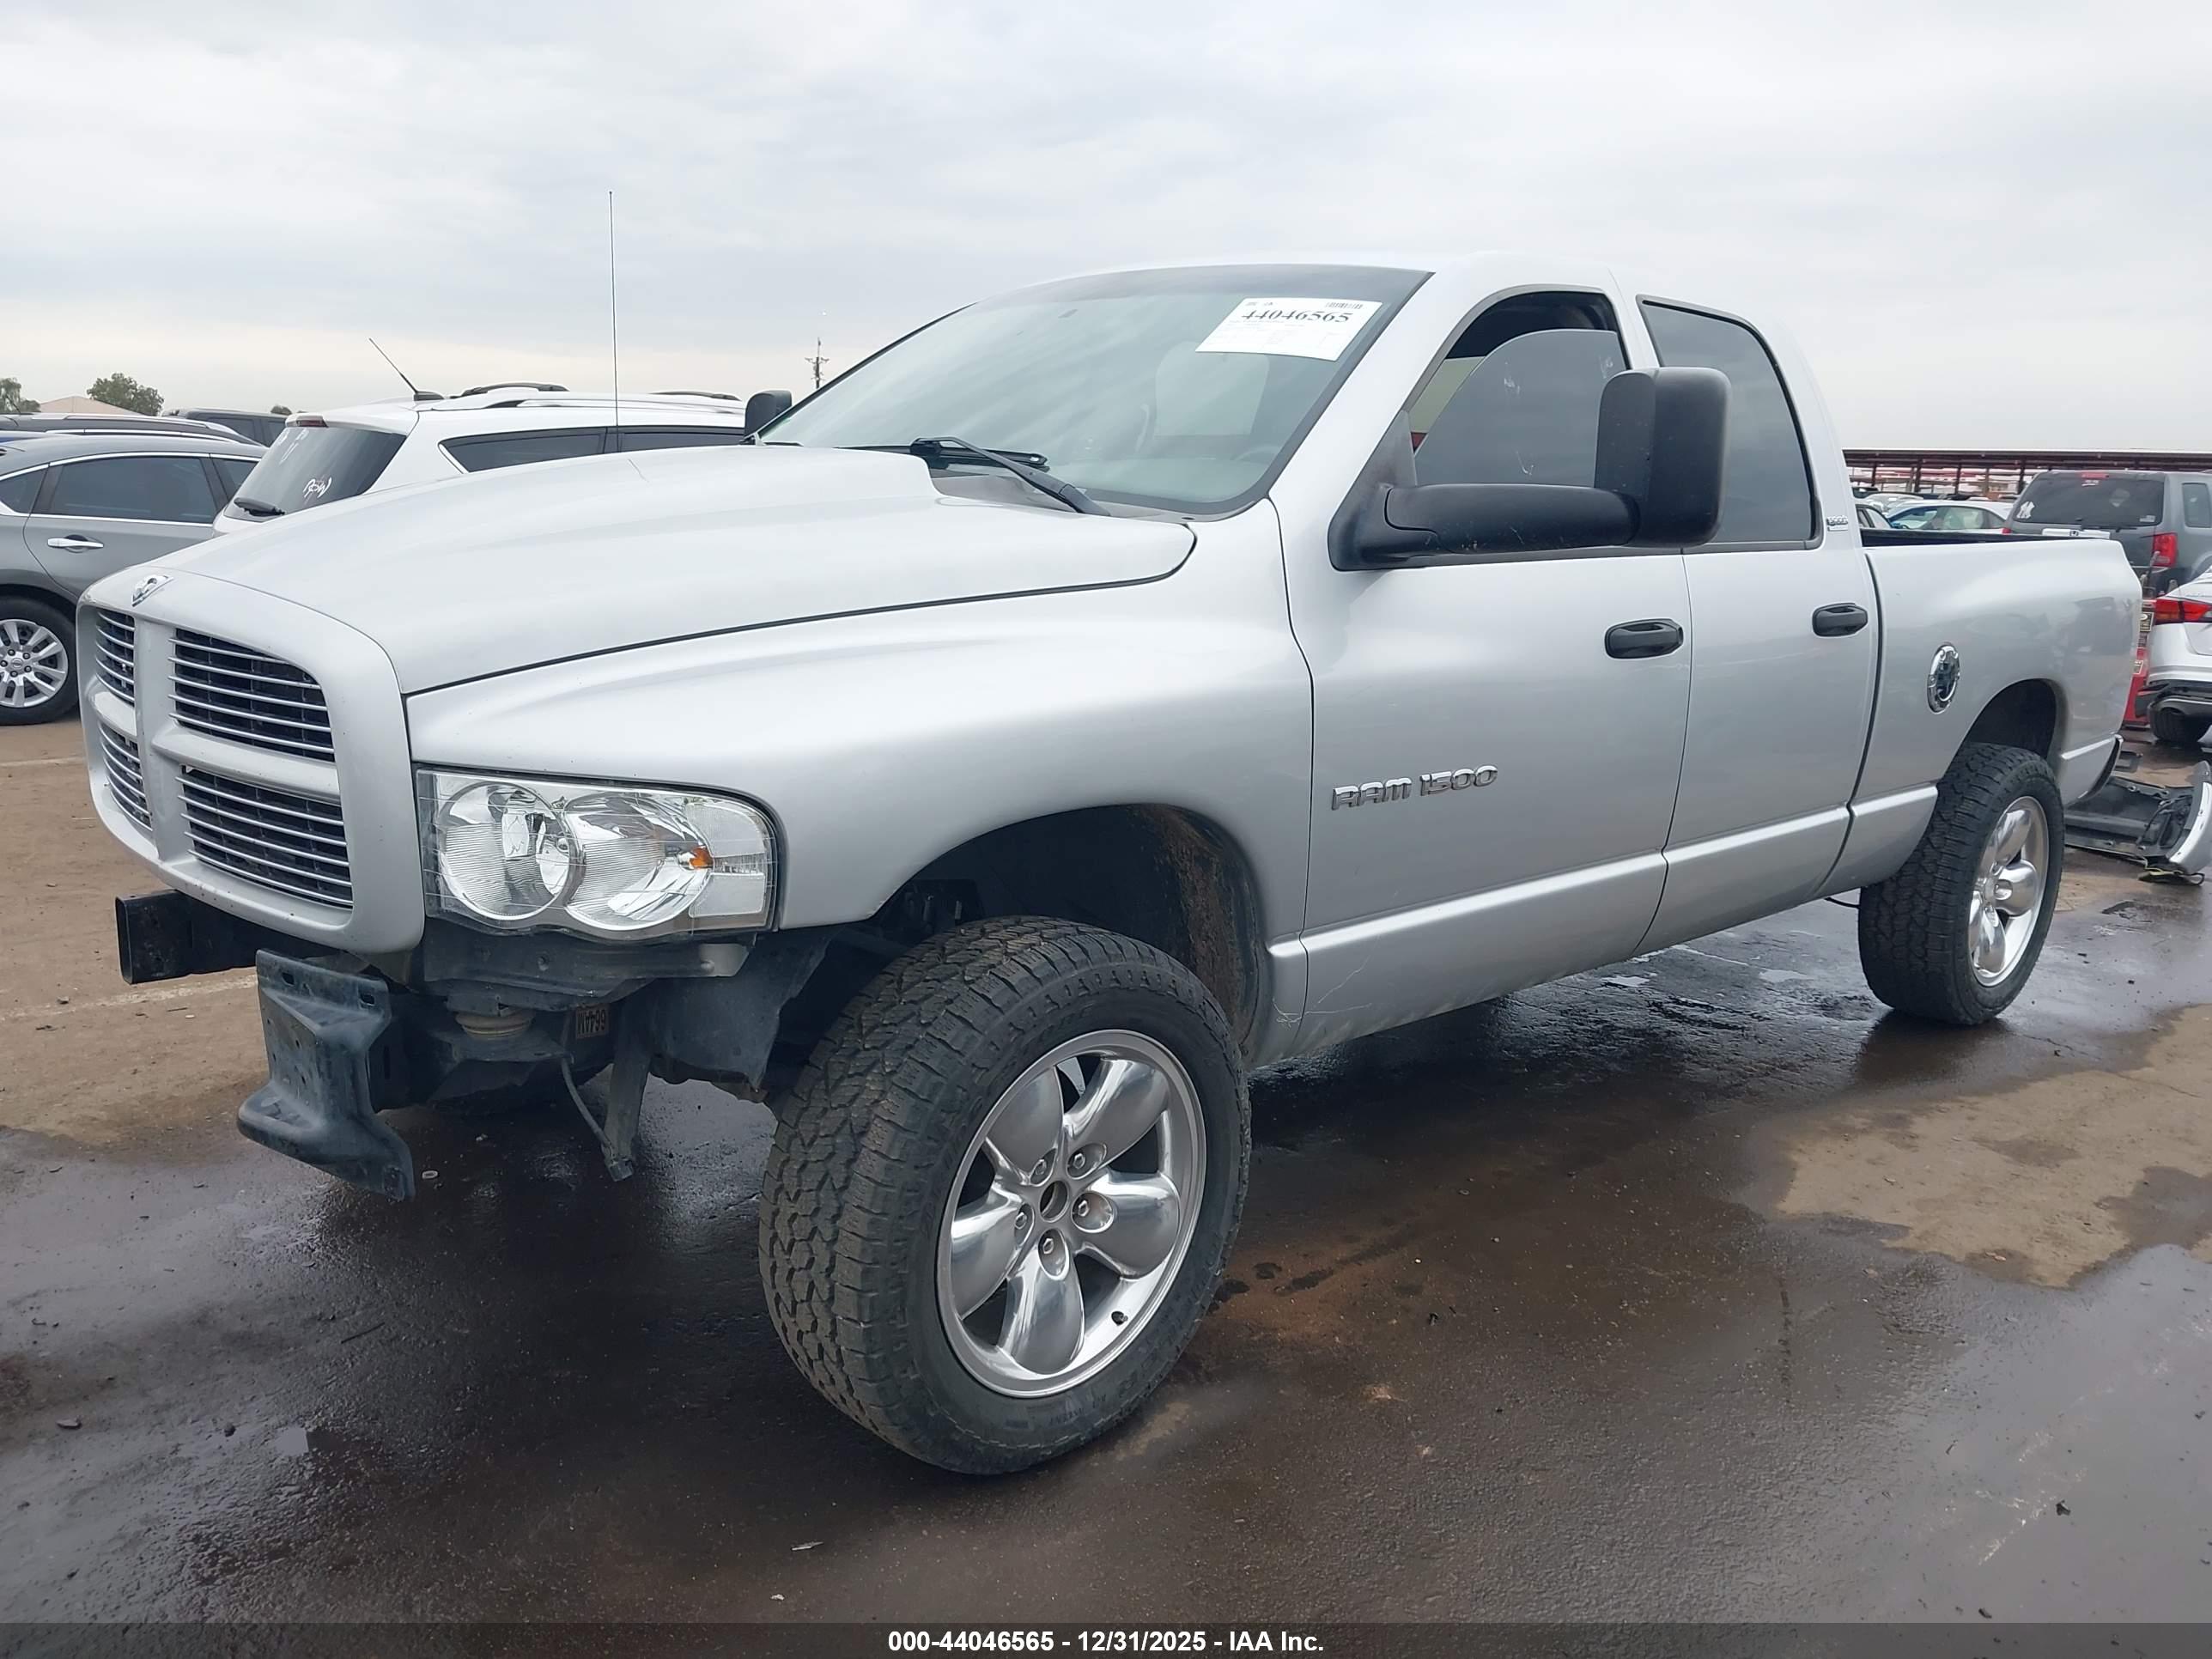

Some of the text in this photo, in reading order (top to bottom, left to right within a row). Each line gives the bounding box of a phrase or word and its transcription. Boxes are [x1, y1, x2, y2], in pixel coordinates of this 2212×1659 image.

[1242, 309, 1353, 323] 44046565
[1331, 764, 1498, 811] RAM 1500
